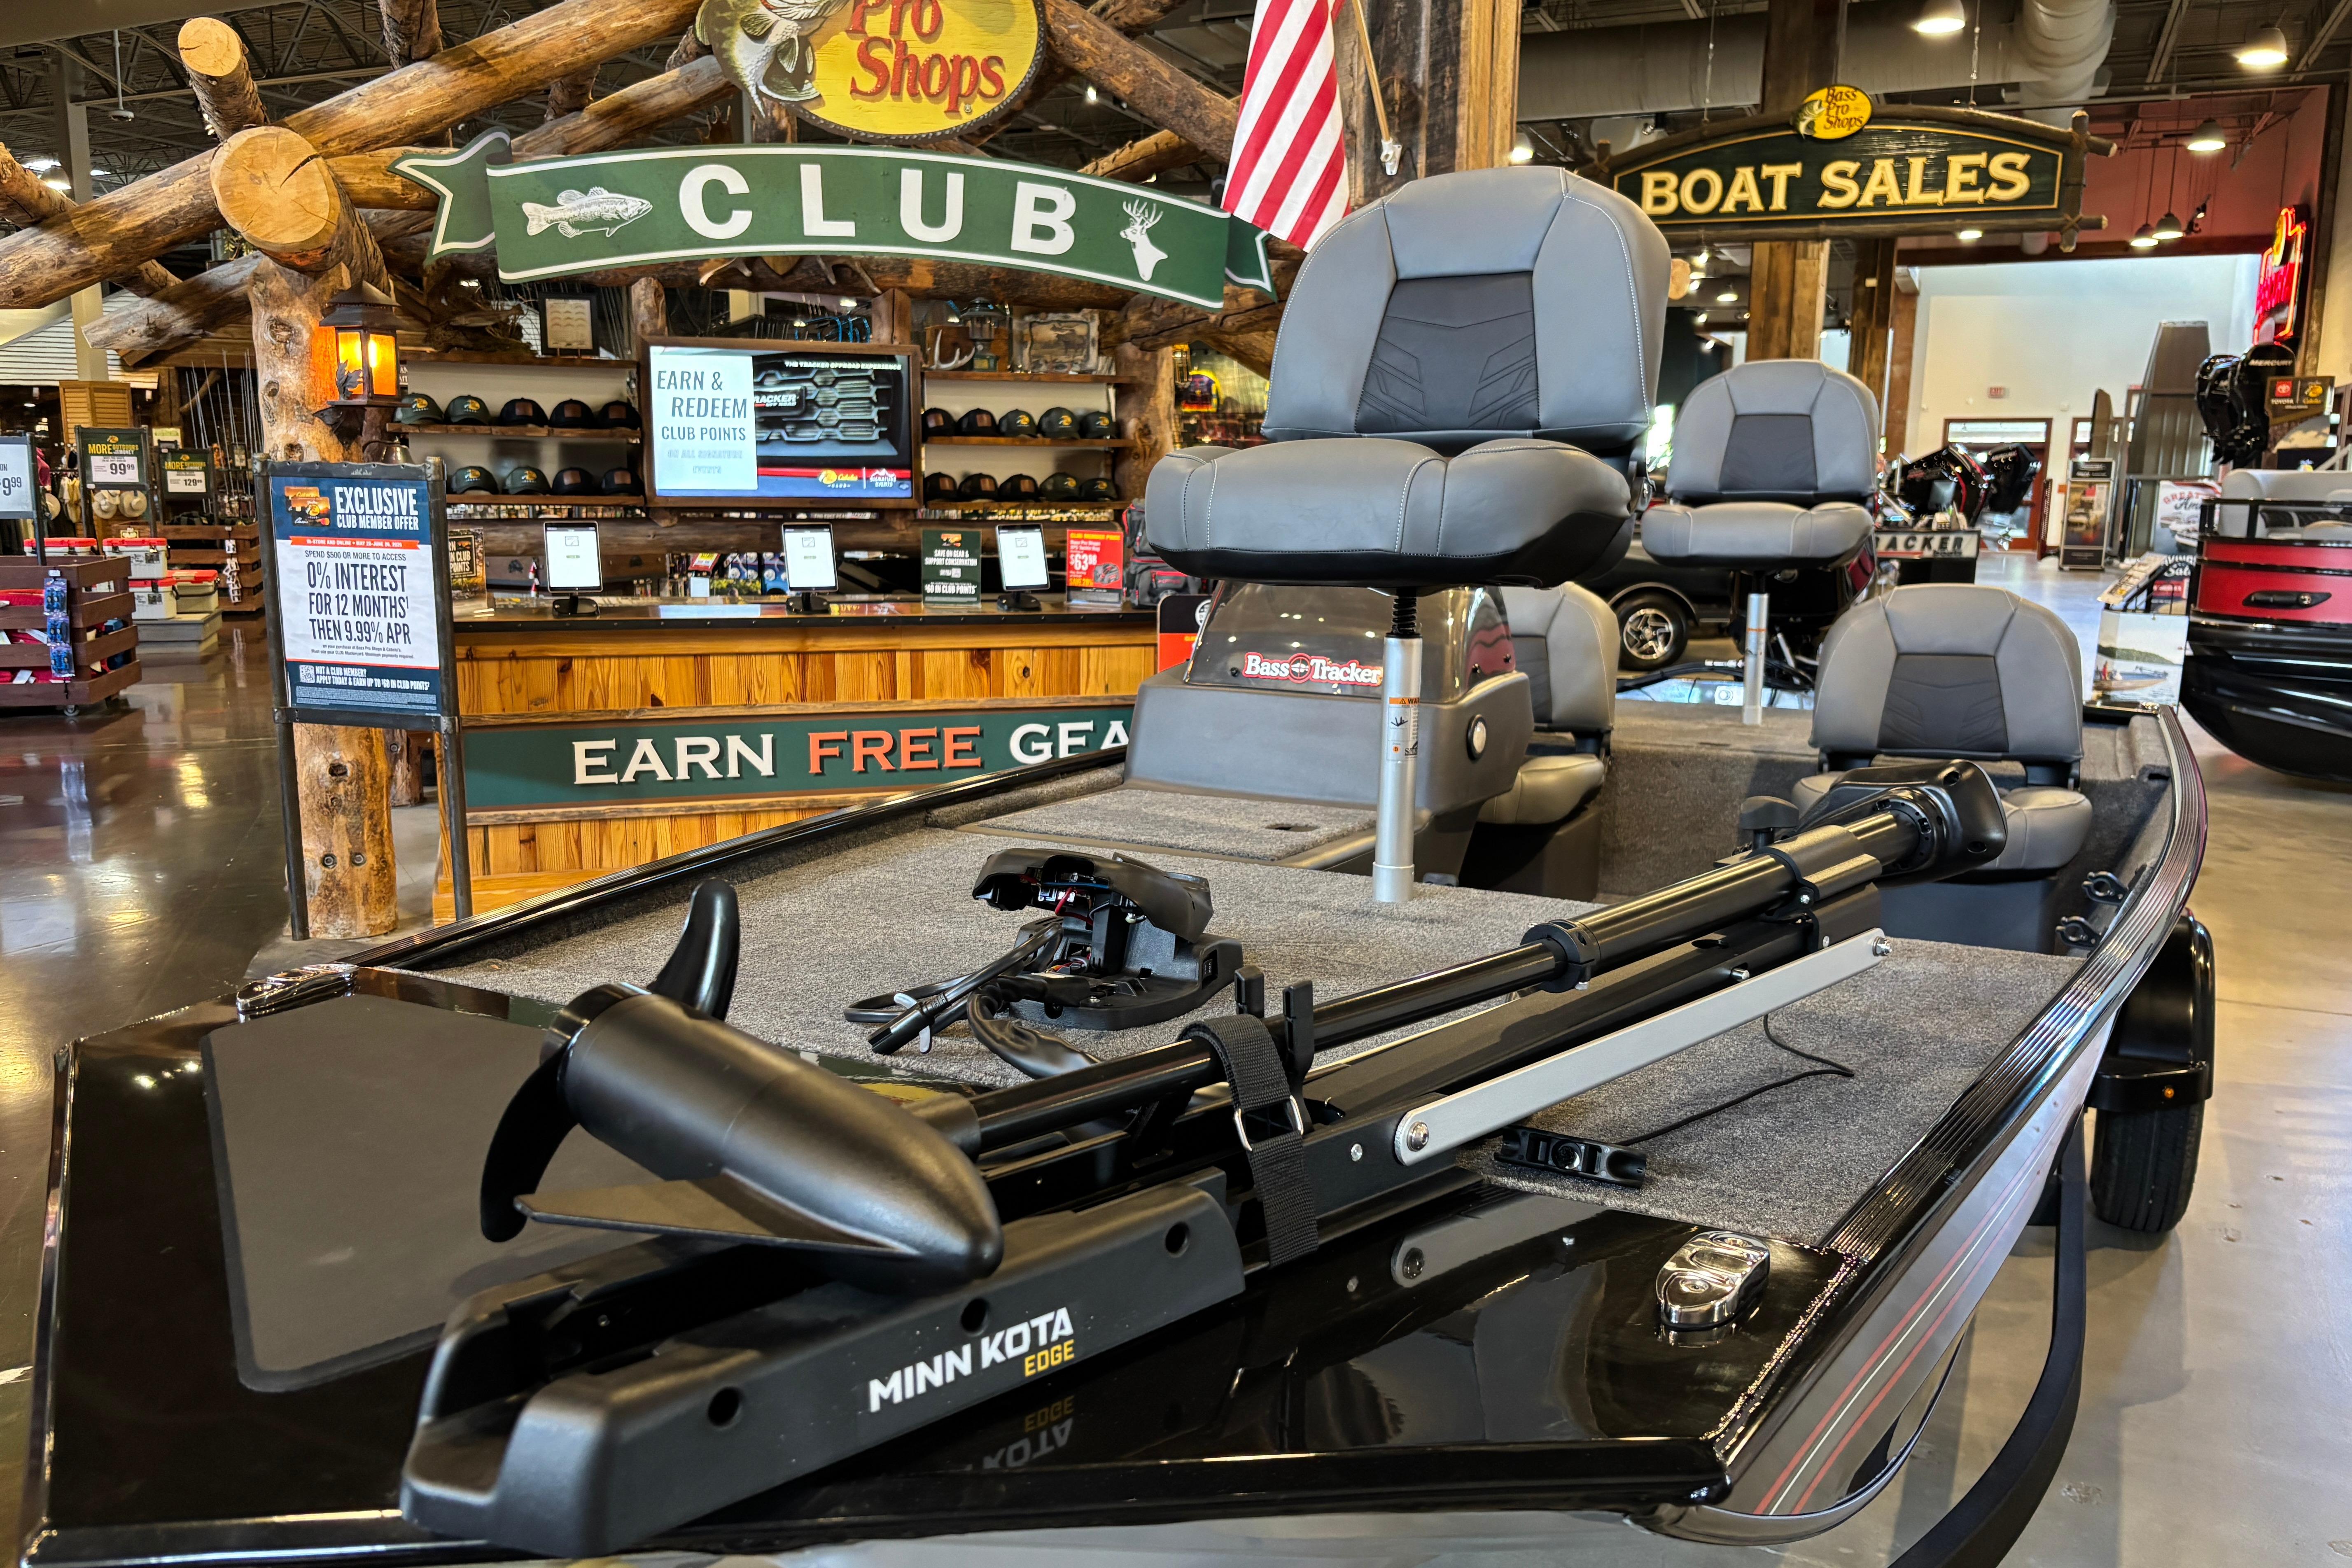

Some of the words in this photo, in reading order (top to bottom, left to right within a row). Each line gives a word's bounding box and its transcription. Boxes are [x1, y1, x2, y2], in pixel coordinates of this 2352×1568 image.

[846, 0, 942, 37] Pro
[850, 36, 1006, 112] Shops
[1826, 87, 1857, 103] Bass
[1825, 102, 1849, 117] Pro
[1823, 116, 1864, 131] Shops
[1641, 161, 1802, 216] BOAT
[1816, 151, 2031, 209] SALES
[679, 164, 1076, 255] CLUB
[657, 371, 704, 390] EARN
[711, 371, 723, 391] &
[672, 397, 747, 418] REDEEM
[662, 426, 695, 440] CLUB
[700, 427, 746, 441] POINTS
[88, 443, 113, 454] MORE
[165, 461, 184, 470] MORE
[334, 486, 418, 516] EXCLUSIVE
[337, 514, 357, 529] CLUB
[359, 515, 393, 530] MEMBER
[394, 516, 419, 531] OFFER
[455, 551, 471, 562] CLUB
[945, 558, 978, 566] CONSERVATION
[307, 562, 331, 589] 0%
[335, 562, 407, 592] INTEREST
[450, 561, 470, 573] POINTS
[935, 585, 941, 593] IN
[942, 585, 956, 594] CLUB
[309, 592, 332, 615] FOR
[335, 593, 349, 616] 12
[309, 618, 342, 641] THEN
[344, 620, 383, 643] 9.99%
[387, 622, 411, 645] APR
[315, 665, 325, 674] NOT
[326, 666, 330, 675] A
[330, 667, 343, 676] CLUB
[343, 667, 366, 677] MEMBER?
[1245, 655, 1289, 677] Bass
[1310, 658, 1381, 684] Tracker
[316, 675, 331, 684] APPLY
[332, 676, 348, 685] TODAY
[348, 677, 353, 686] &
[353, 677, 366, 686] EARN
[367, 678, 373, 687] UP
[373, 679, 381, 688] TO
[390, 679, 396, 688] IN
[397, 680, 410, 689] CLUB
[573, 733, 775, 785] EARN
[808, 725, 981, 774] FREE
[869, 1343, 972, 1413] MINN
[981, 1307, 1073, 1369] KOTA
[1024, 1339, 1075, 1378] EDGE
